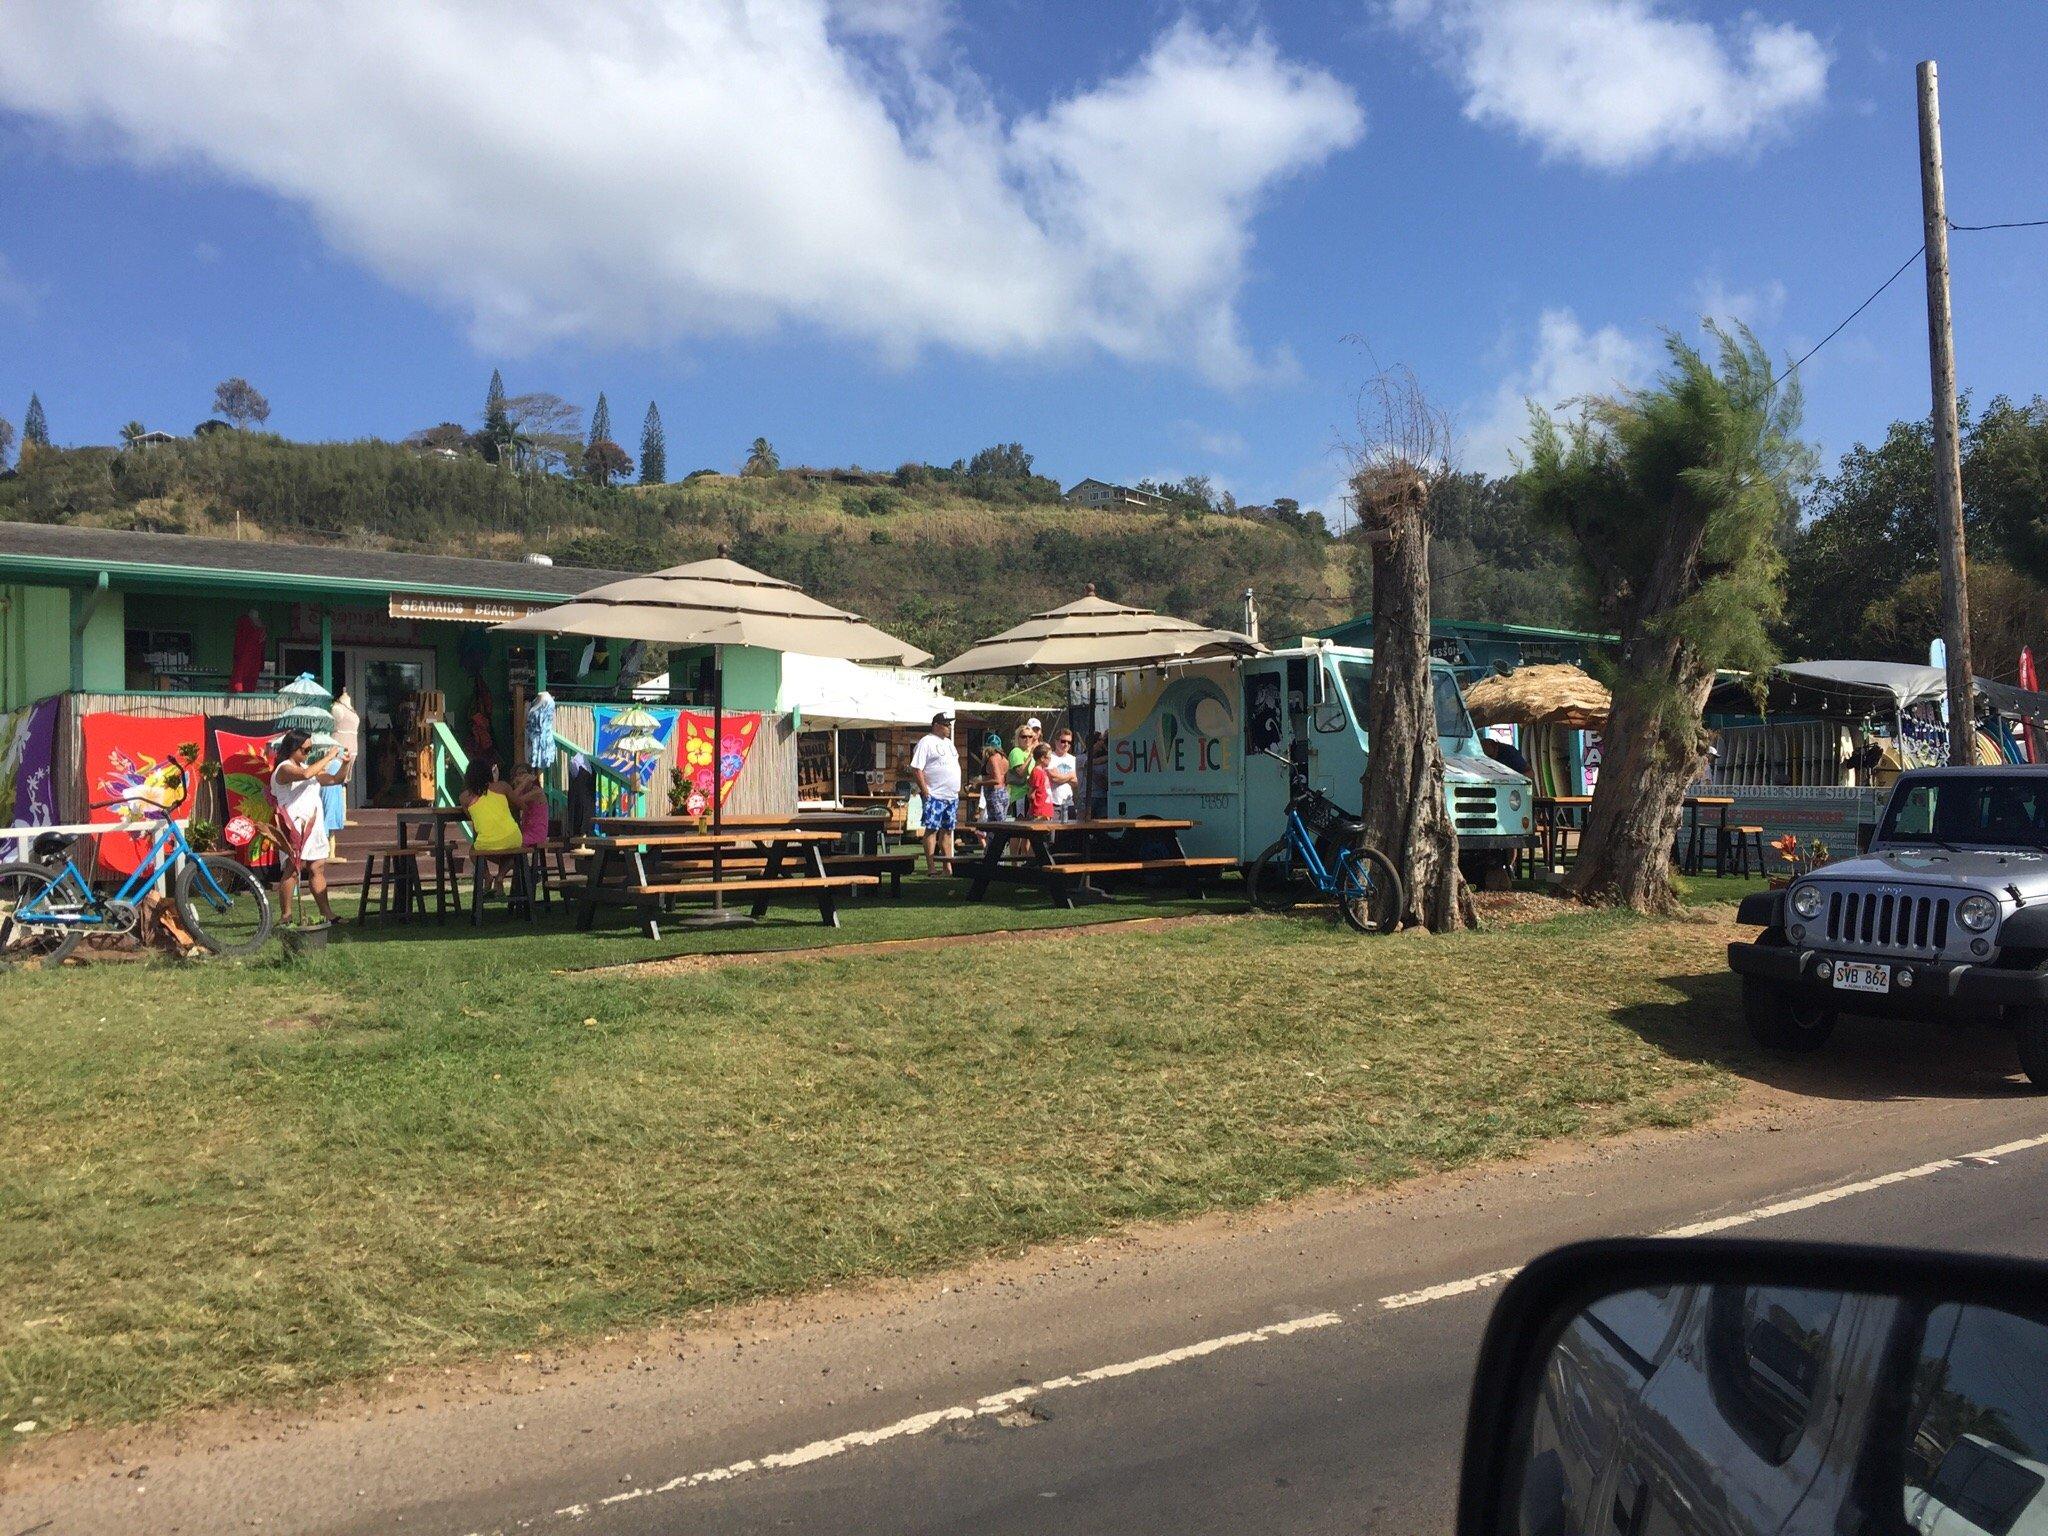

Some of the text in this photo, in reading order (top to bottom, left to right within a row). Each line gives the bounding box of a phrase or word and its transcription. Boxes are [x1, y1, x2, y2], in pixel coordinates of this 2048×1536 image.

[401, 598, 464, 615] SEAMAIDS
[475, 603, 515, 618] BEACH
[1115, 722, 1232, 774] SHAVE ICE
[1687, 785, 1867, 801] ORTH SHORE SURF SHOP
[1836, 967, 1887, 986] SVB 862
